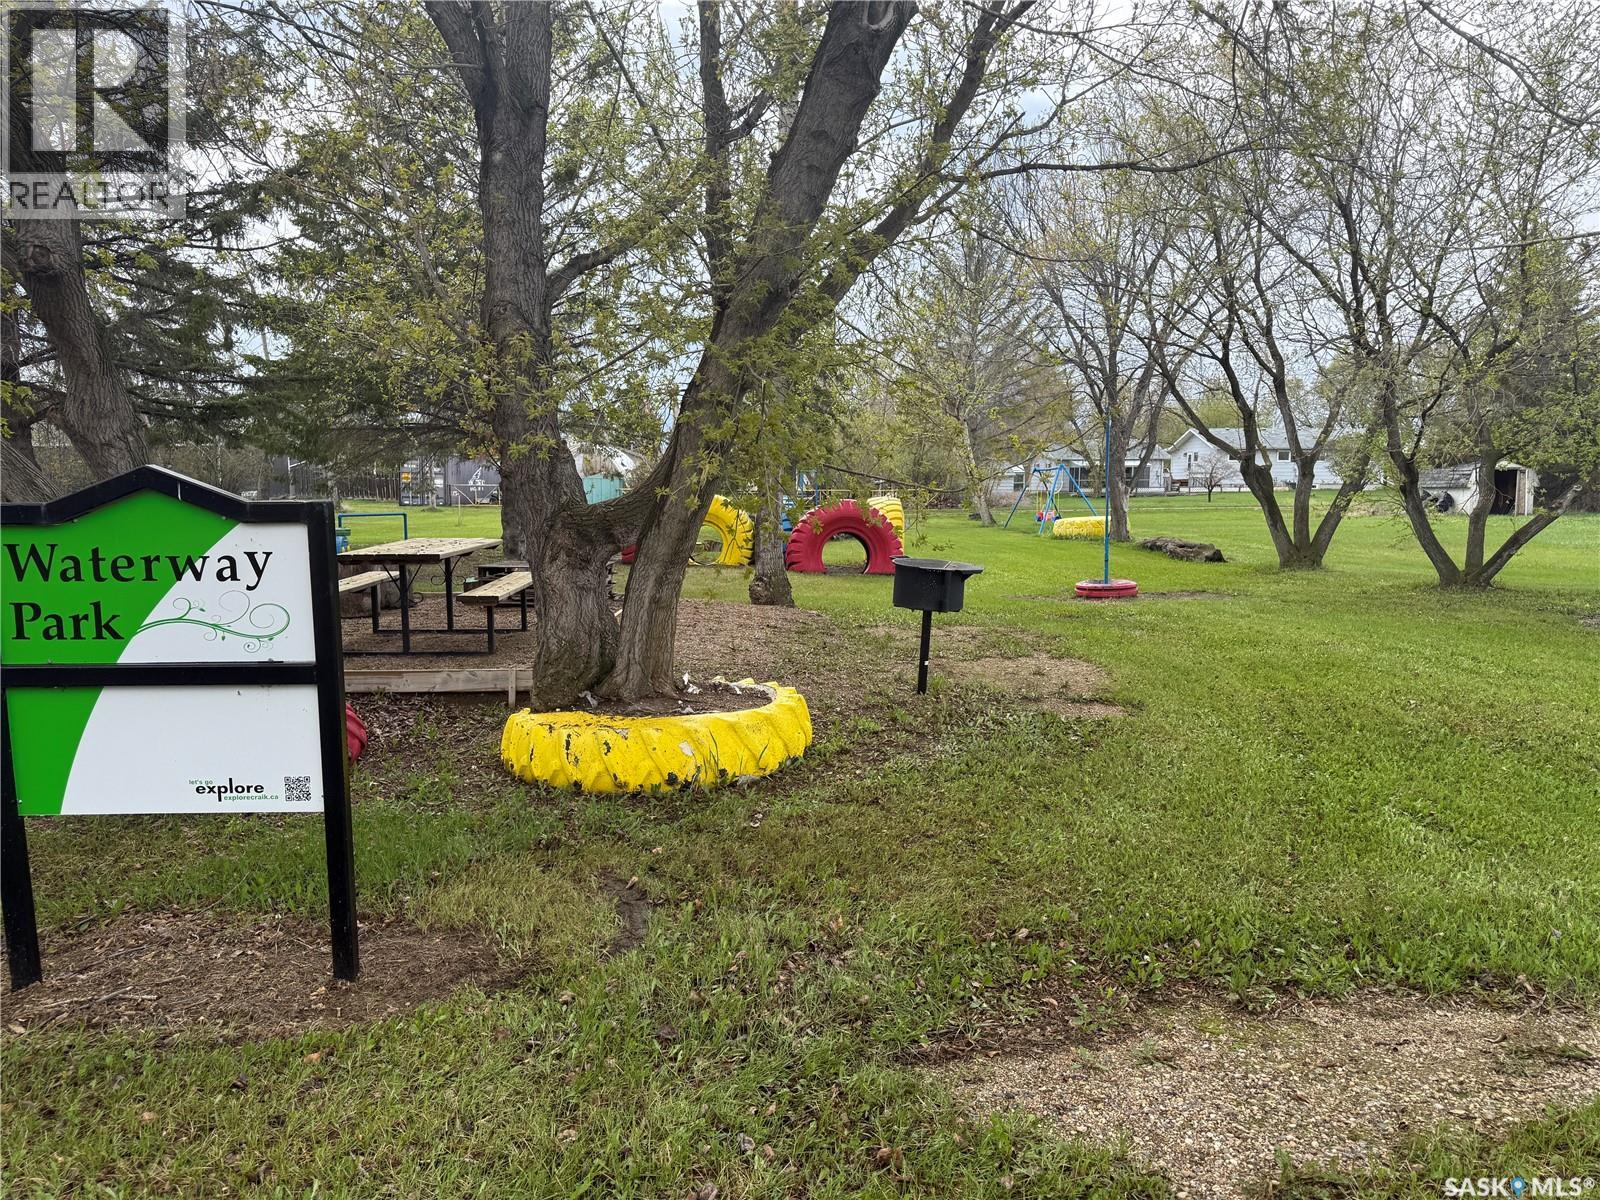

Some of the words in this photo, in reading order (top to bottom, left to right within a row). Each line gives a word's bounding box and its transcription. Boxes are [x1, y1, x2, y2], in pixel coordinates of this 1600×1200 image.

[2, 543, 273, 591] Waterway
[9, 600, 125, 641] Park
[195, 778, 264, 802] explore
